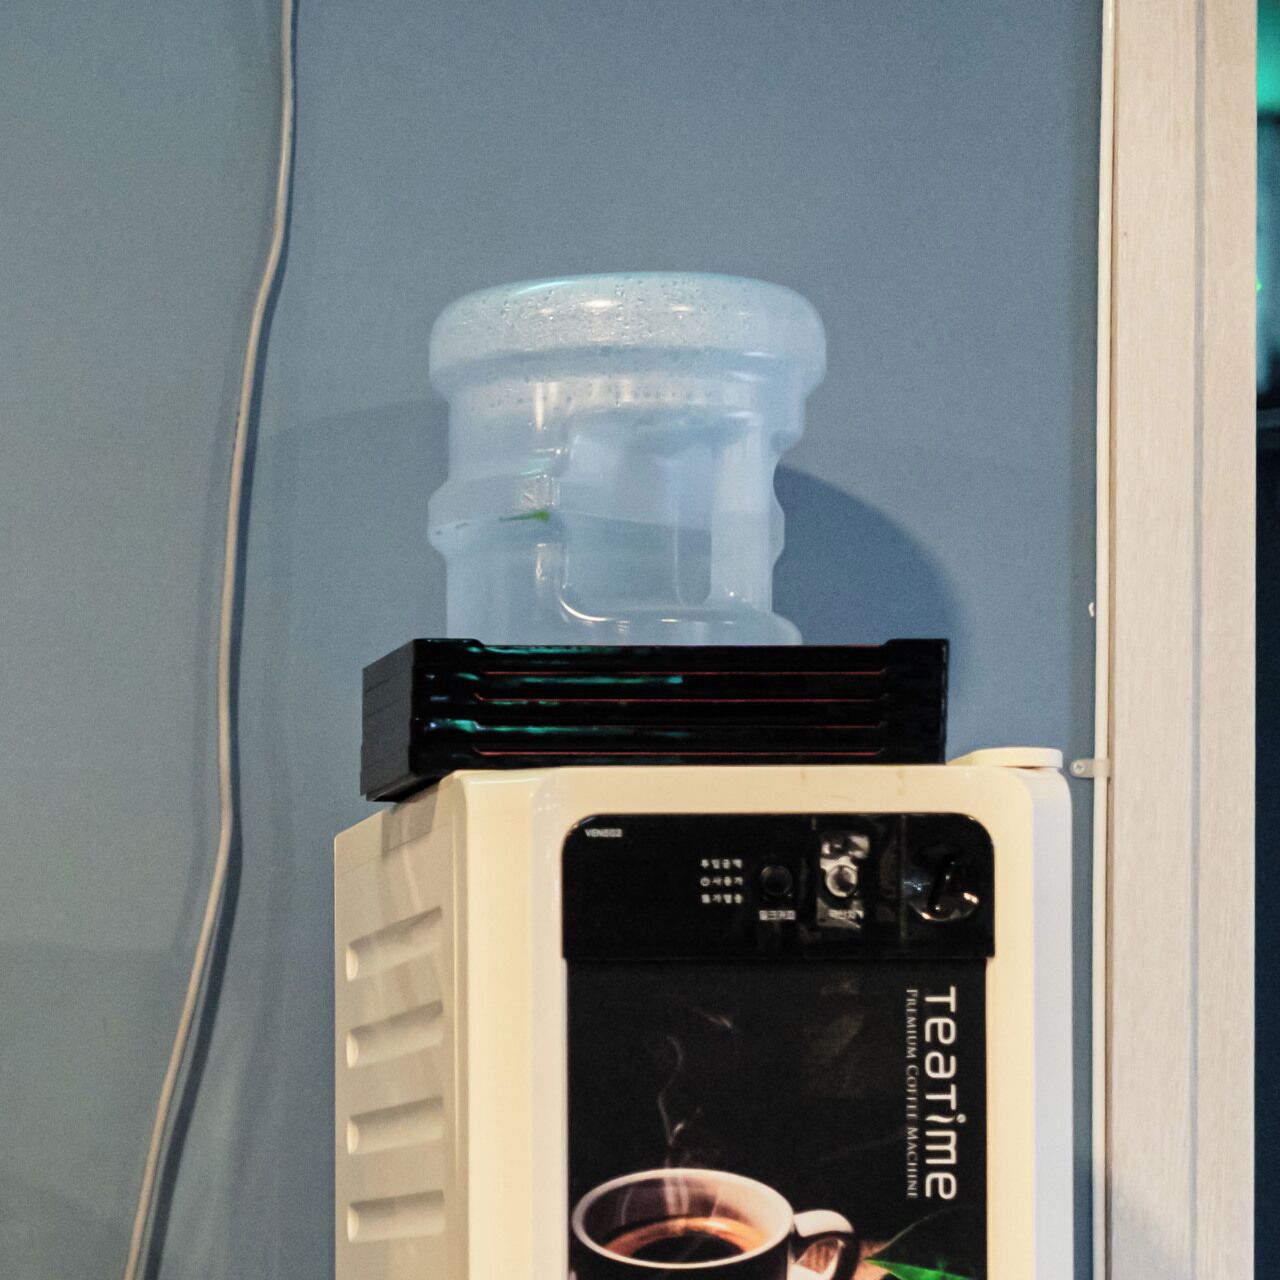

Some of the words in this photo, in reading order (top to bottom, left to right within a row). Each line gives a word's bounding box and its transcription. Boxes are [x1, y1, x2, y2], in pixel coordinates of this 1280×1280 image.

[906, 989, 919, 1059] PREMIUM
[906, 1064, 919, 1119] COFFEE
[906, 1126, 919, 1199] MACHINE
